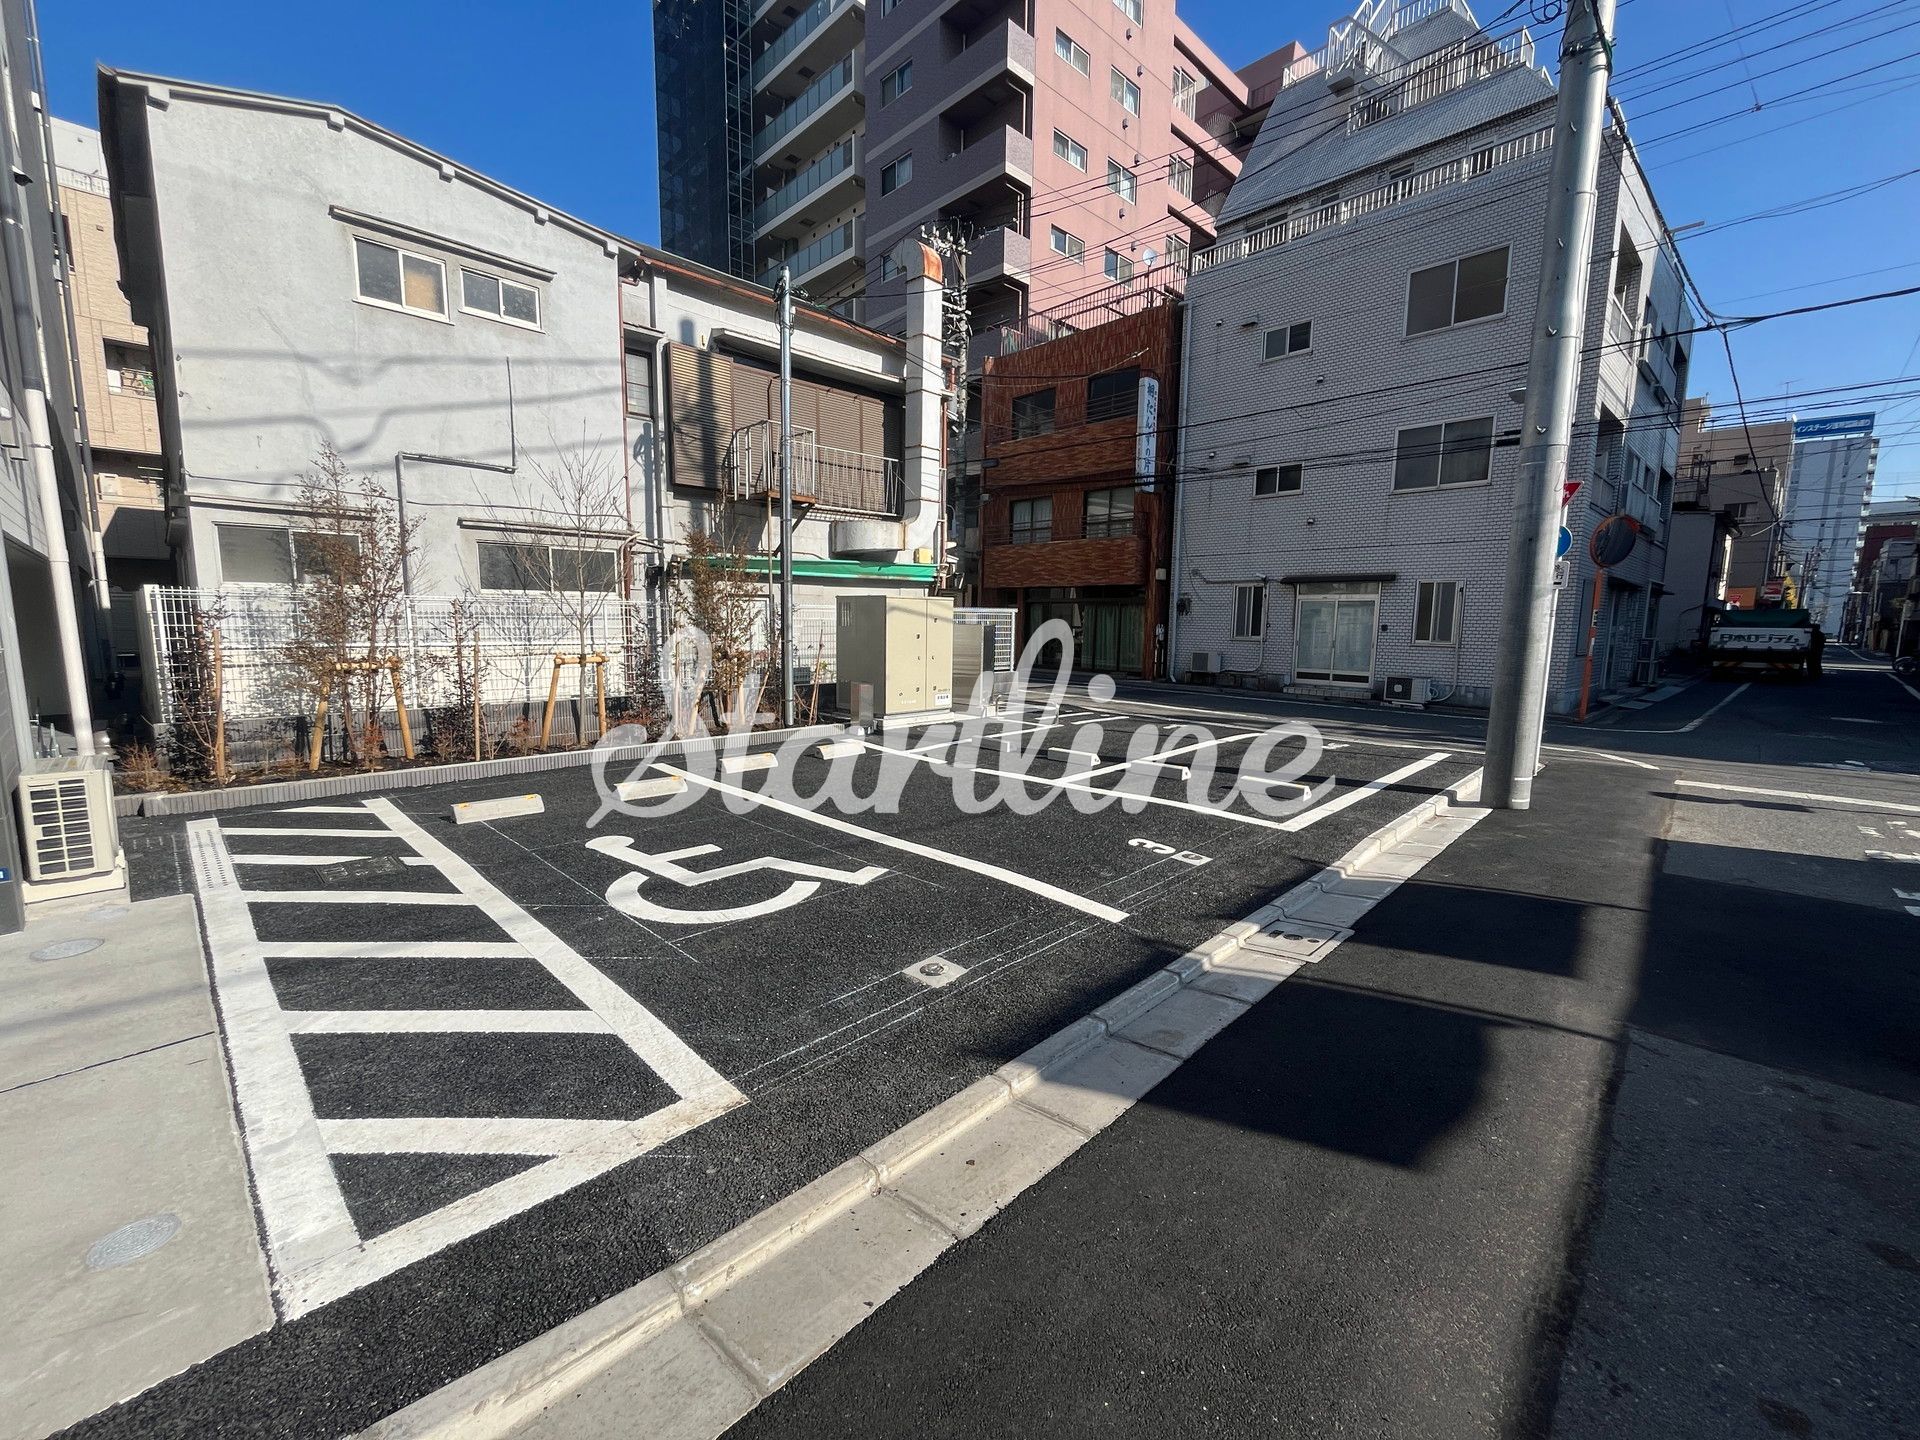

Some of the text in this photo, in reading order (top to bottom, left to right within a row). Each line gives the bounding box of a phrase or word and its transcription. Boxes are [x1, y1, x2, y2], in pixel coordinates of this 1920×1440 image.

[1719, 633, 1799, 644] 日本ロジテム
[1128, 838, 1176, 855] 3
